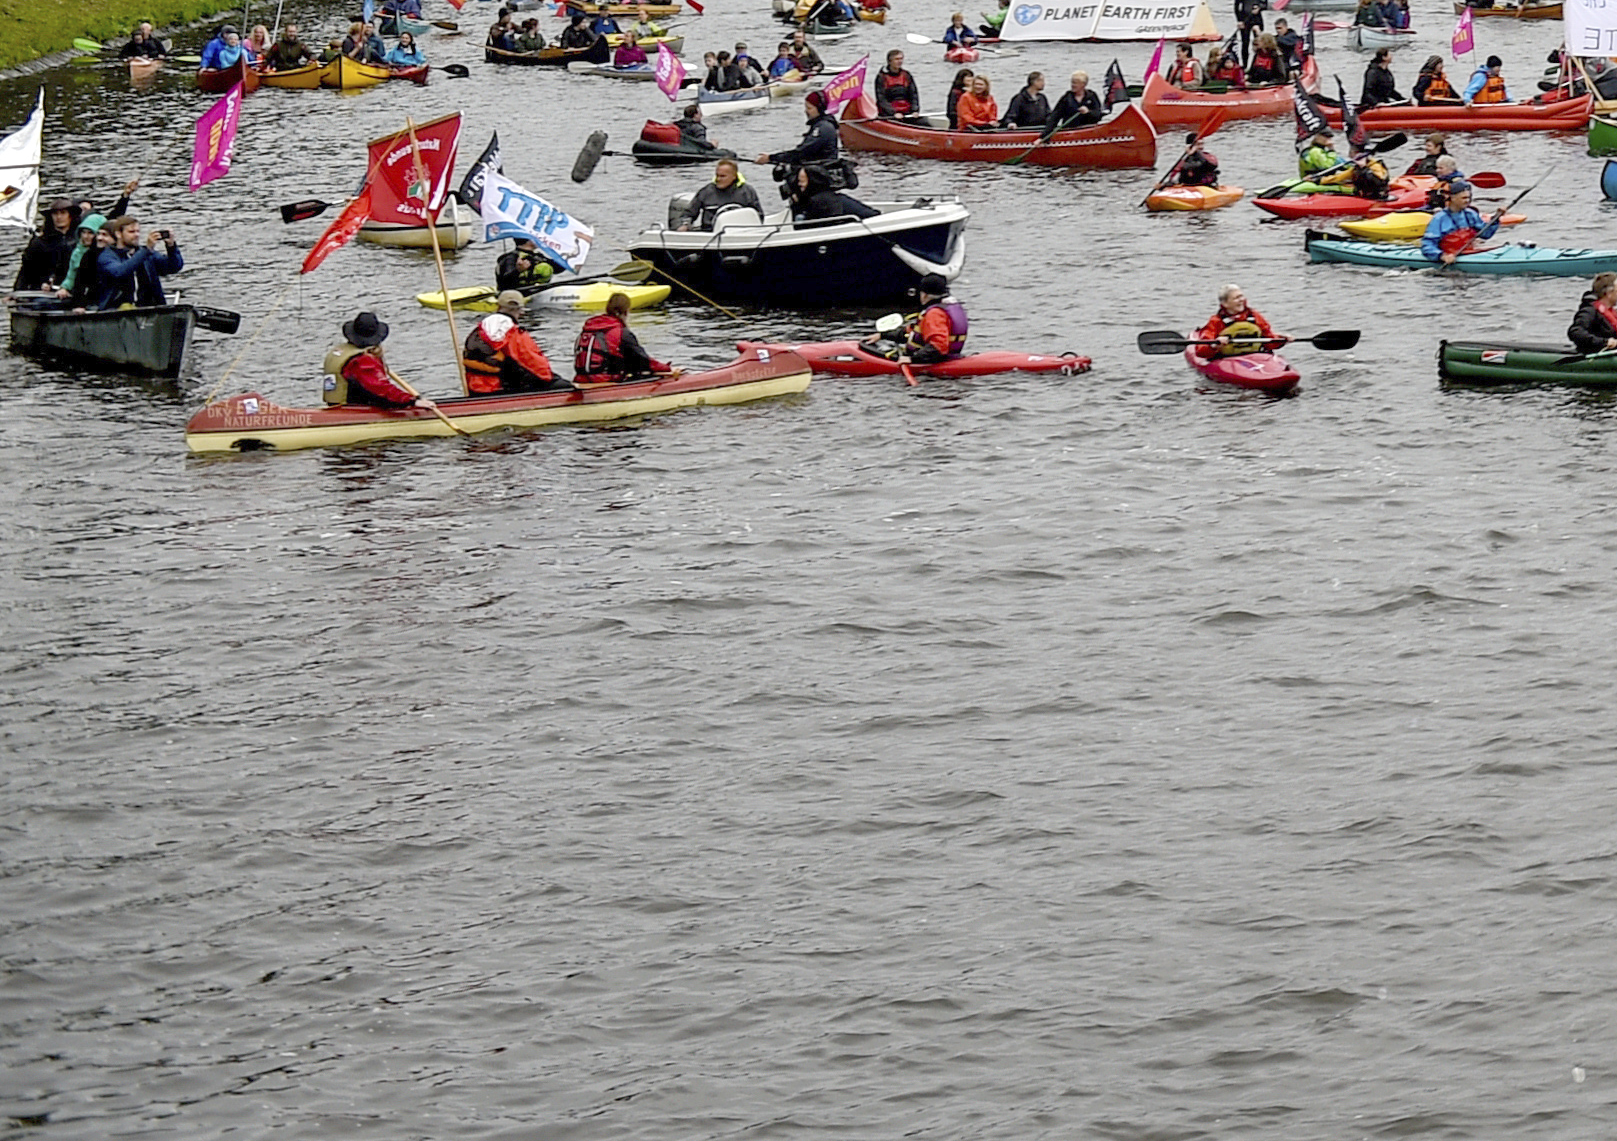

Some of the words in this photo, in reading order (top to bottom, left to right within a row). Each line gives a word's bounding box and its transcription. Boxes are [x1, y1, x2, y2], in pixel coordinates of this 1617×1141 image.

[1044, 5, 1098, 21] PLANET
[1102, 5, 1150, 20] EARTH
[1154, 5, 1195, 20] FIRST
[224, 414, 313, 427] NATURFREUNDE
